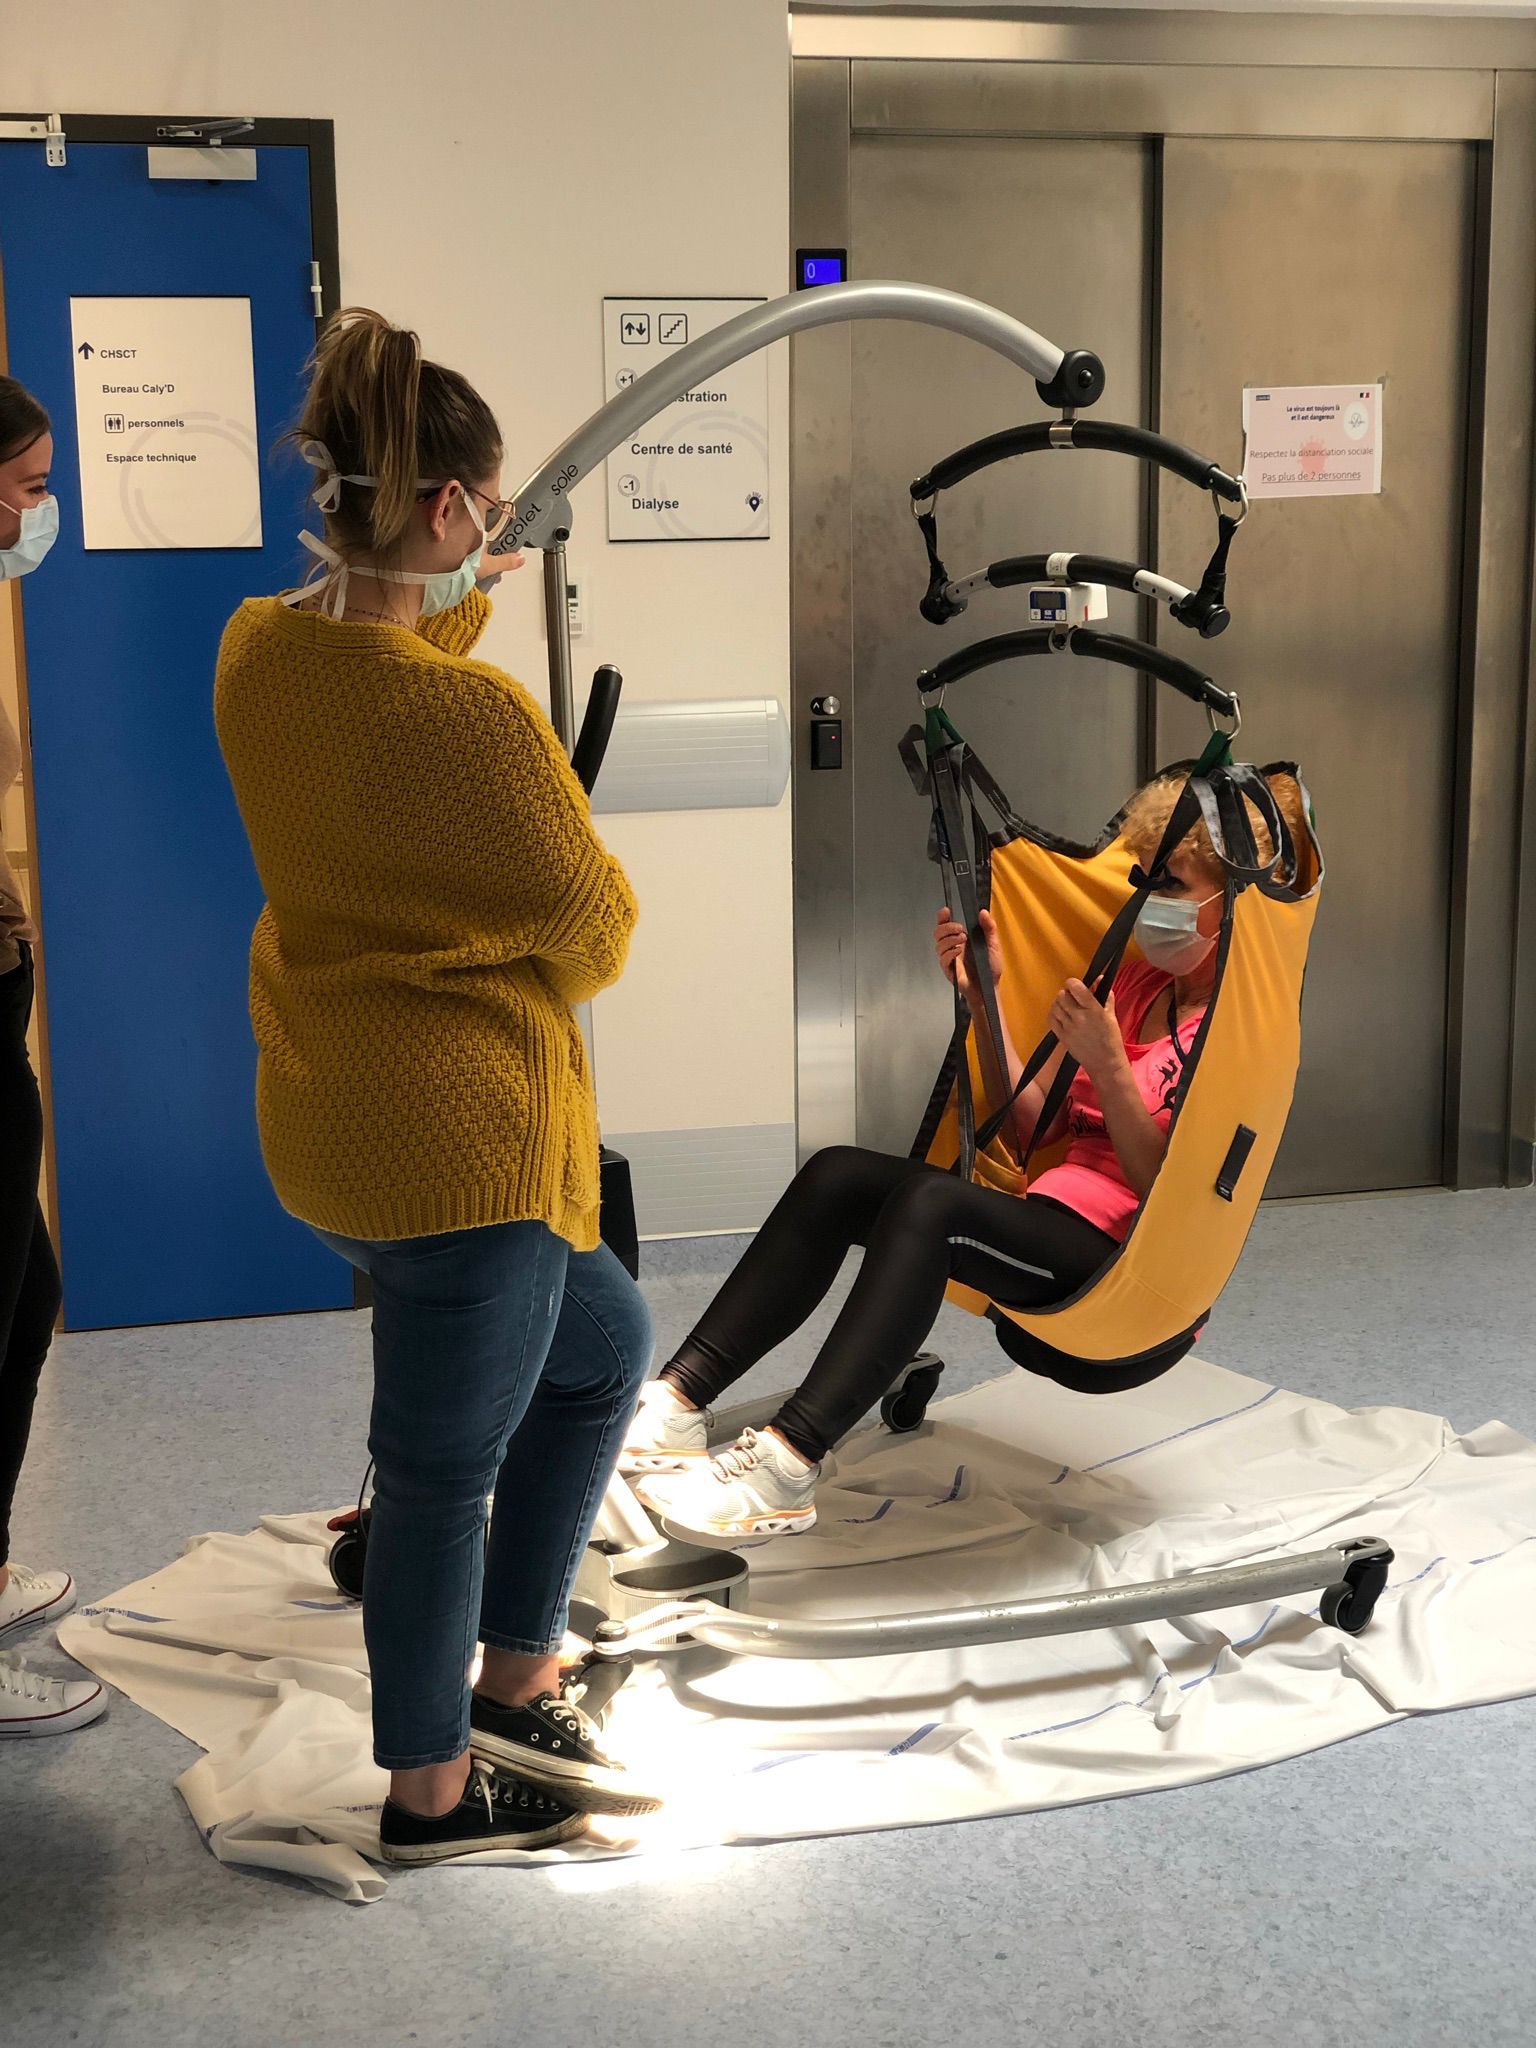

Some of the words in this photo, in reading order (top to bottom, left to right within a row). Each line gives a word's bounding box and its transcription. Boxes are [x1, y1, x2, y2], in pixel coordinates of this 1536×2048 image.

[807, 262, 816, 279] 0
[100, 349, 137, 359] CHSCT
[102, 384, 139, 394] Bureau
[142, 384, 175, 395] Caly'D
[128, 419, 184, 429] personnels
[631, 443, 674, 454] Centre
[678, 443, 694, 454] de
[697, 442, 733, 454] santé
[1290, 449, 1296, 457] la
[1347, 447, 1374, 456] sociale
[106, 453, 144, 464] Espace
[147, 453, 196, 464] technique
[551, 464, 579, 496] sole
[1262, 473, 1277, 482] Pas
[1278, 472, 1296, 483] plus
[1297, 471, 1309, 481] de
[1318, 471, 1362, 482] personnes
[623, 480, 635, 491] -1
[632, 498, 679, 511] Dialyse
